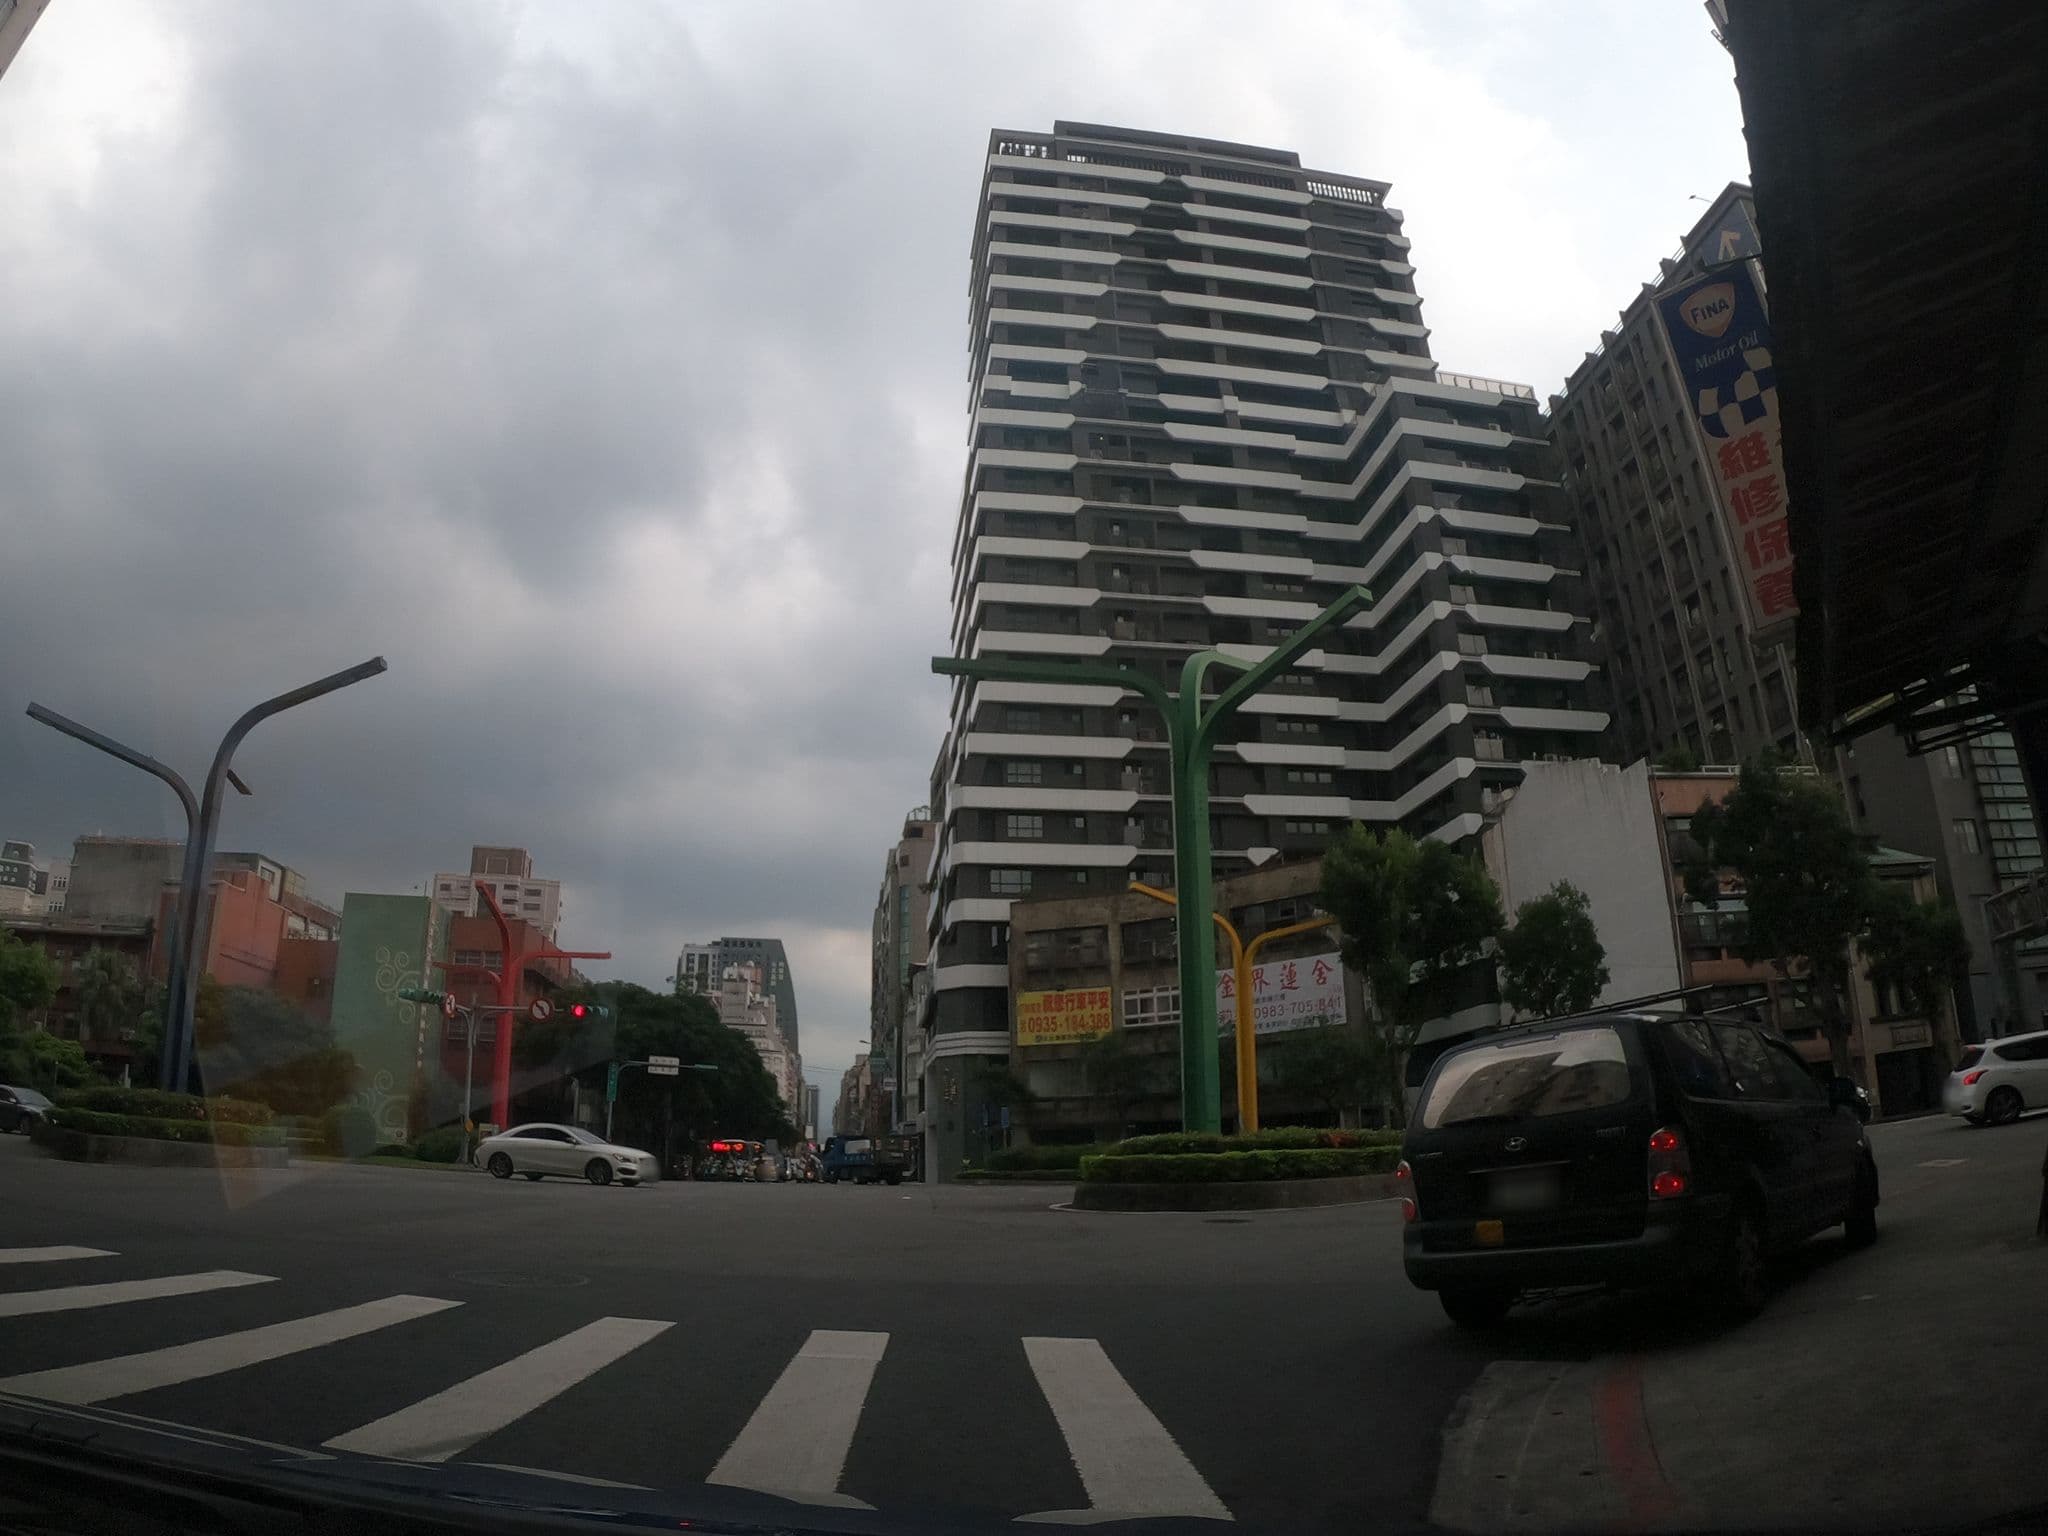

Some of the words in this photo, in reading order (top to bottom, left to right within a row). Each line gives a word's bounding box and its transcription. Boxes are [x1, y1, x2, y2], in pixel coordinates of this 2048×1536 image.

[1690, 297, 1730, 326] FINA
[1694, 342, 1736, 374] Motor
[1735, 330, 1759, 354] Oil
